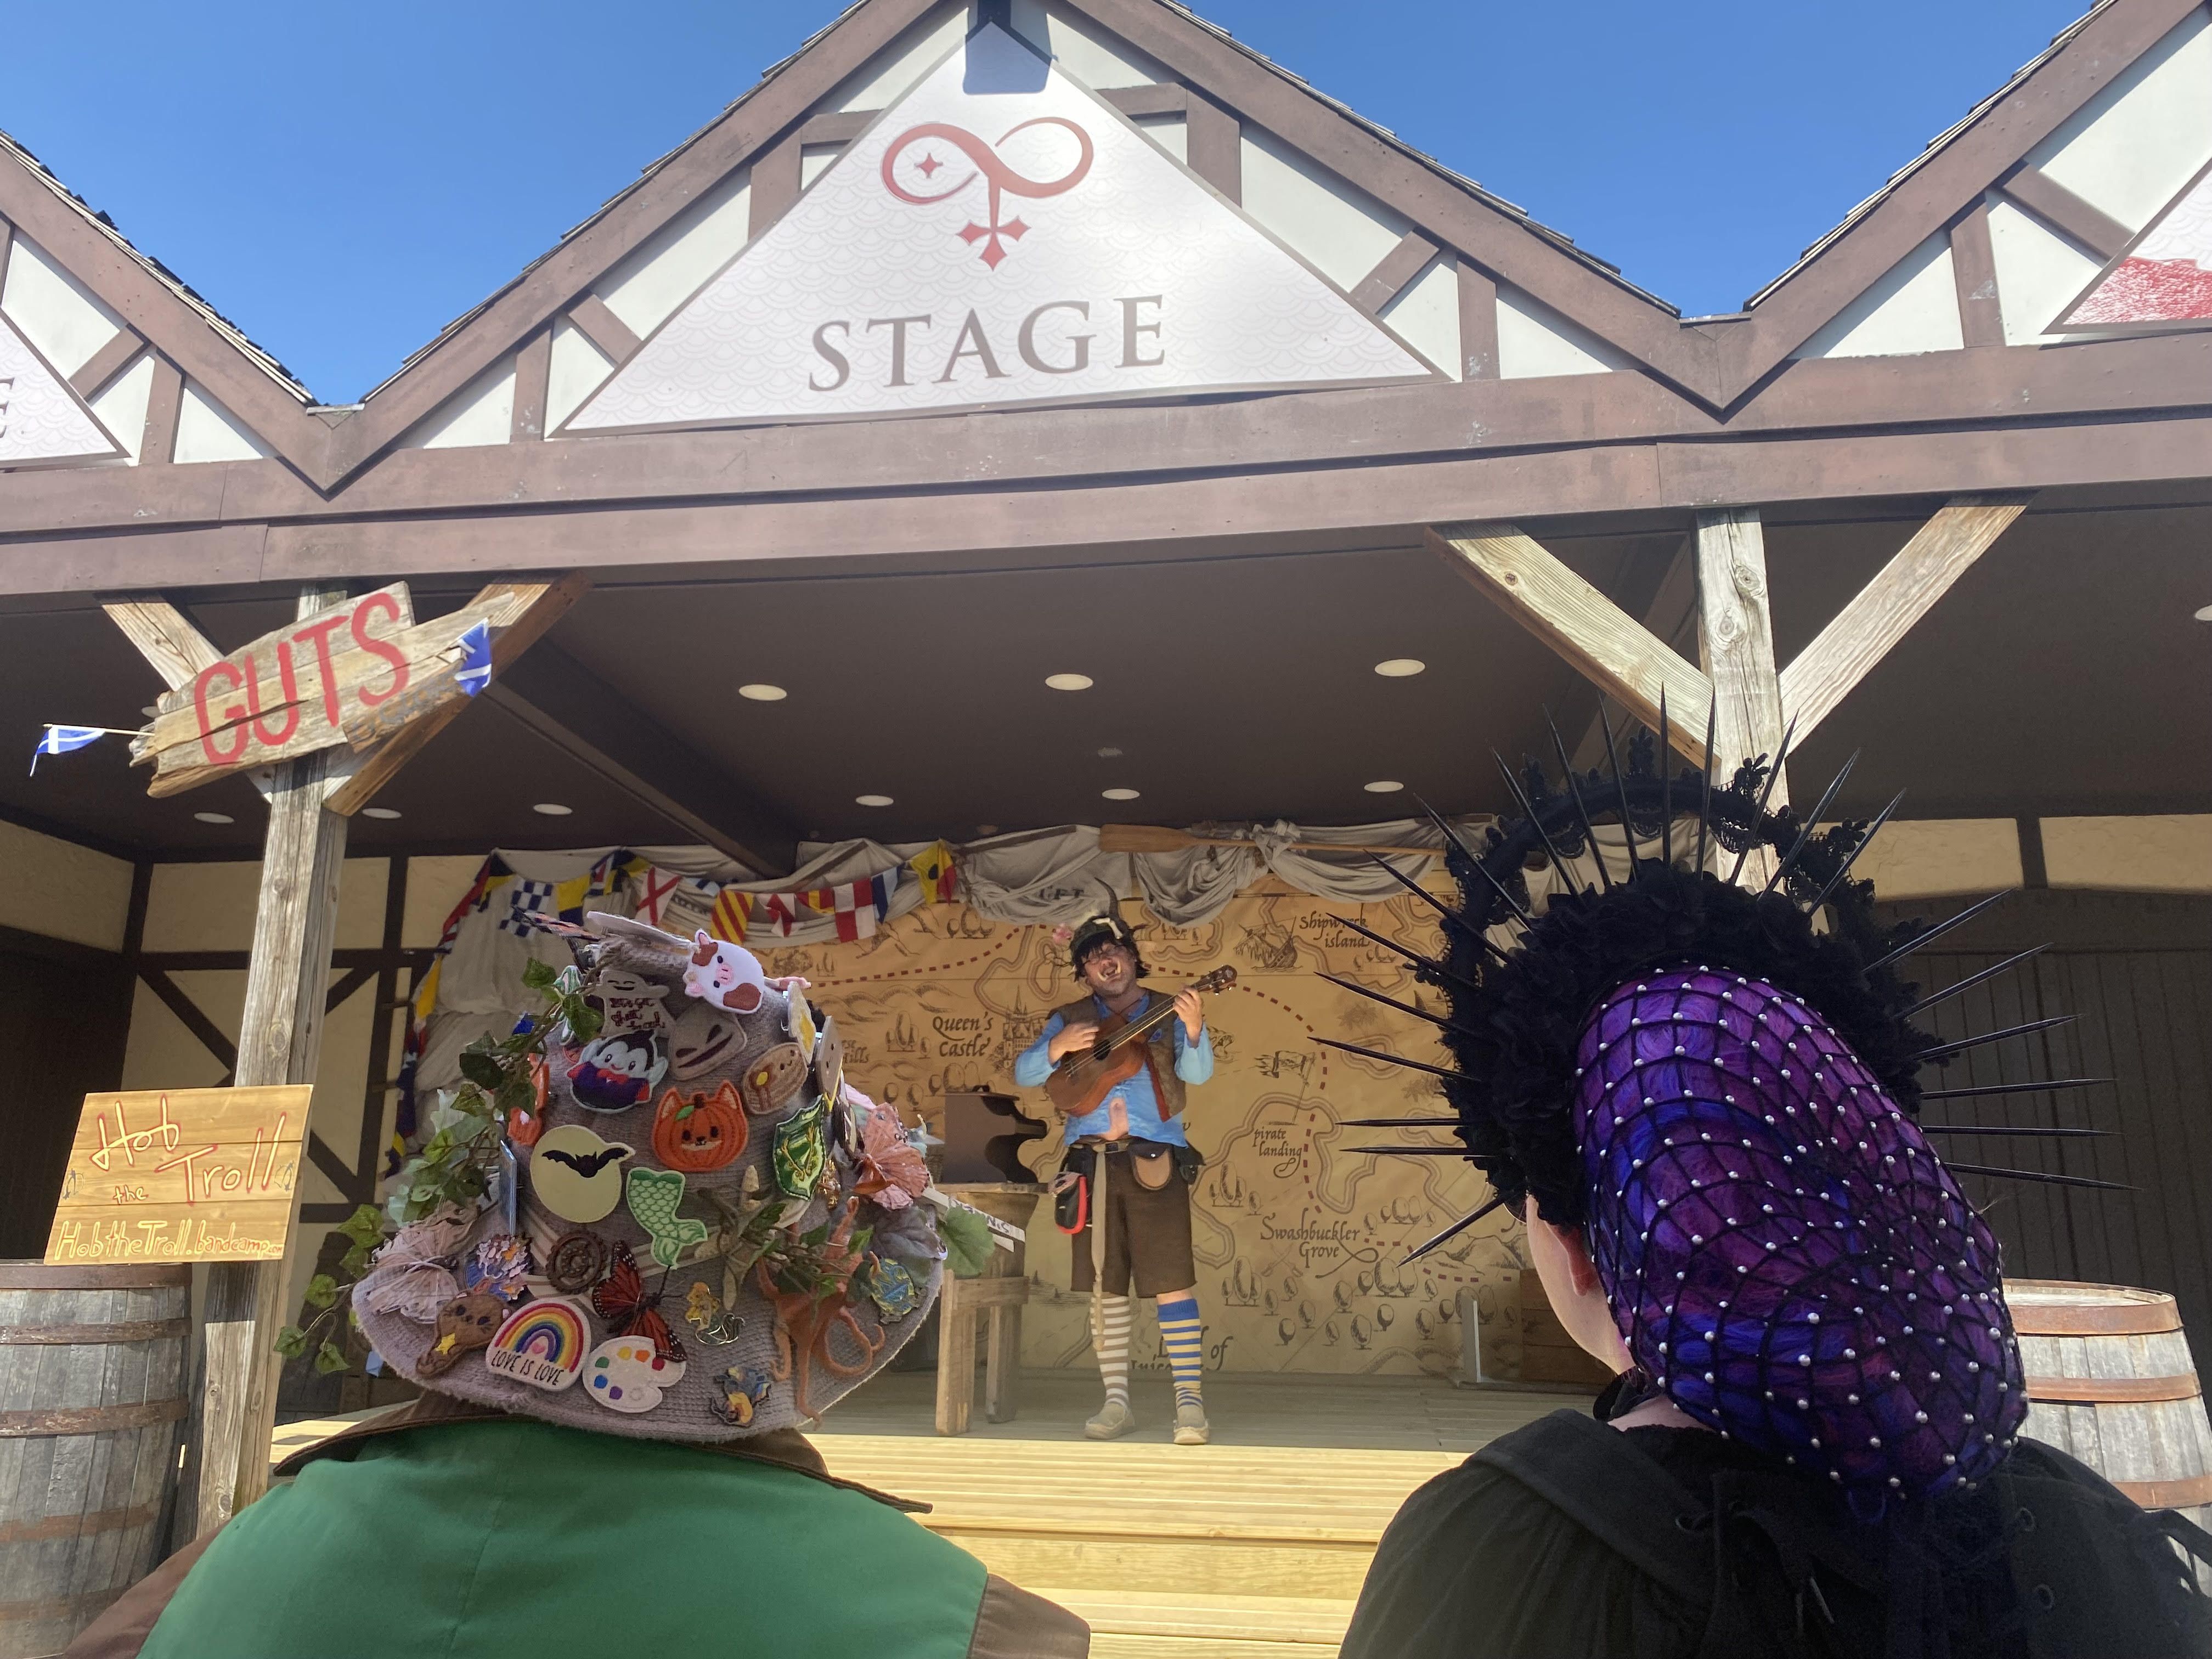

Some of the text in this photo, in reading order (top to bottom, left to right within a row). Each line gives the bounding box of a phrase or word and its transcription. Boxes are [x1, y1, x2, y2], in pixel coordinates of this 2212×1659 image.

[809, 295, 1165, 391] STAGE
[194, 592, 409, 765] GUTS
[933, 1011, 994, 1041] Queen's
[89, 1093, 181, 1171] Hob
[1252, 1126, 1286, 1147] pirate
[113, 1111, 287, 1206] the Troll
[1259, 1141, 1302, 1178] landing
[1261, 1207, 1360, 1241] Swashbuckler
[1299, 1242, 1340, 1268] Grove
[491, 1350, 565, 1386] LOVE IS LOVE
[1211, 1336, 1234, 1370] of
